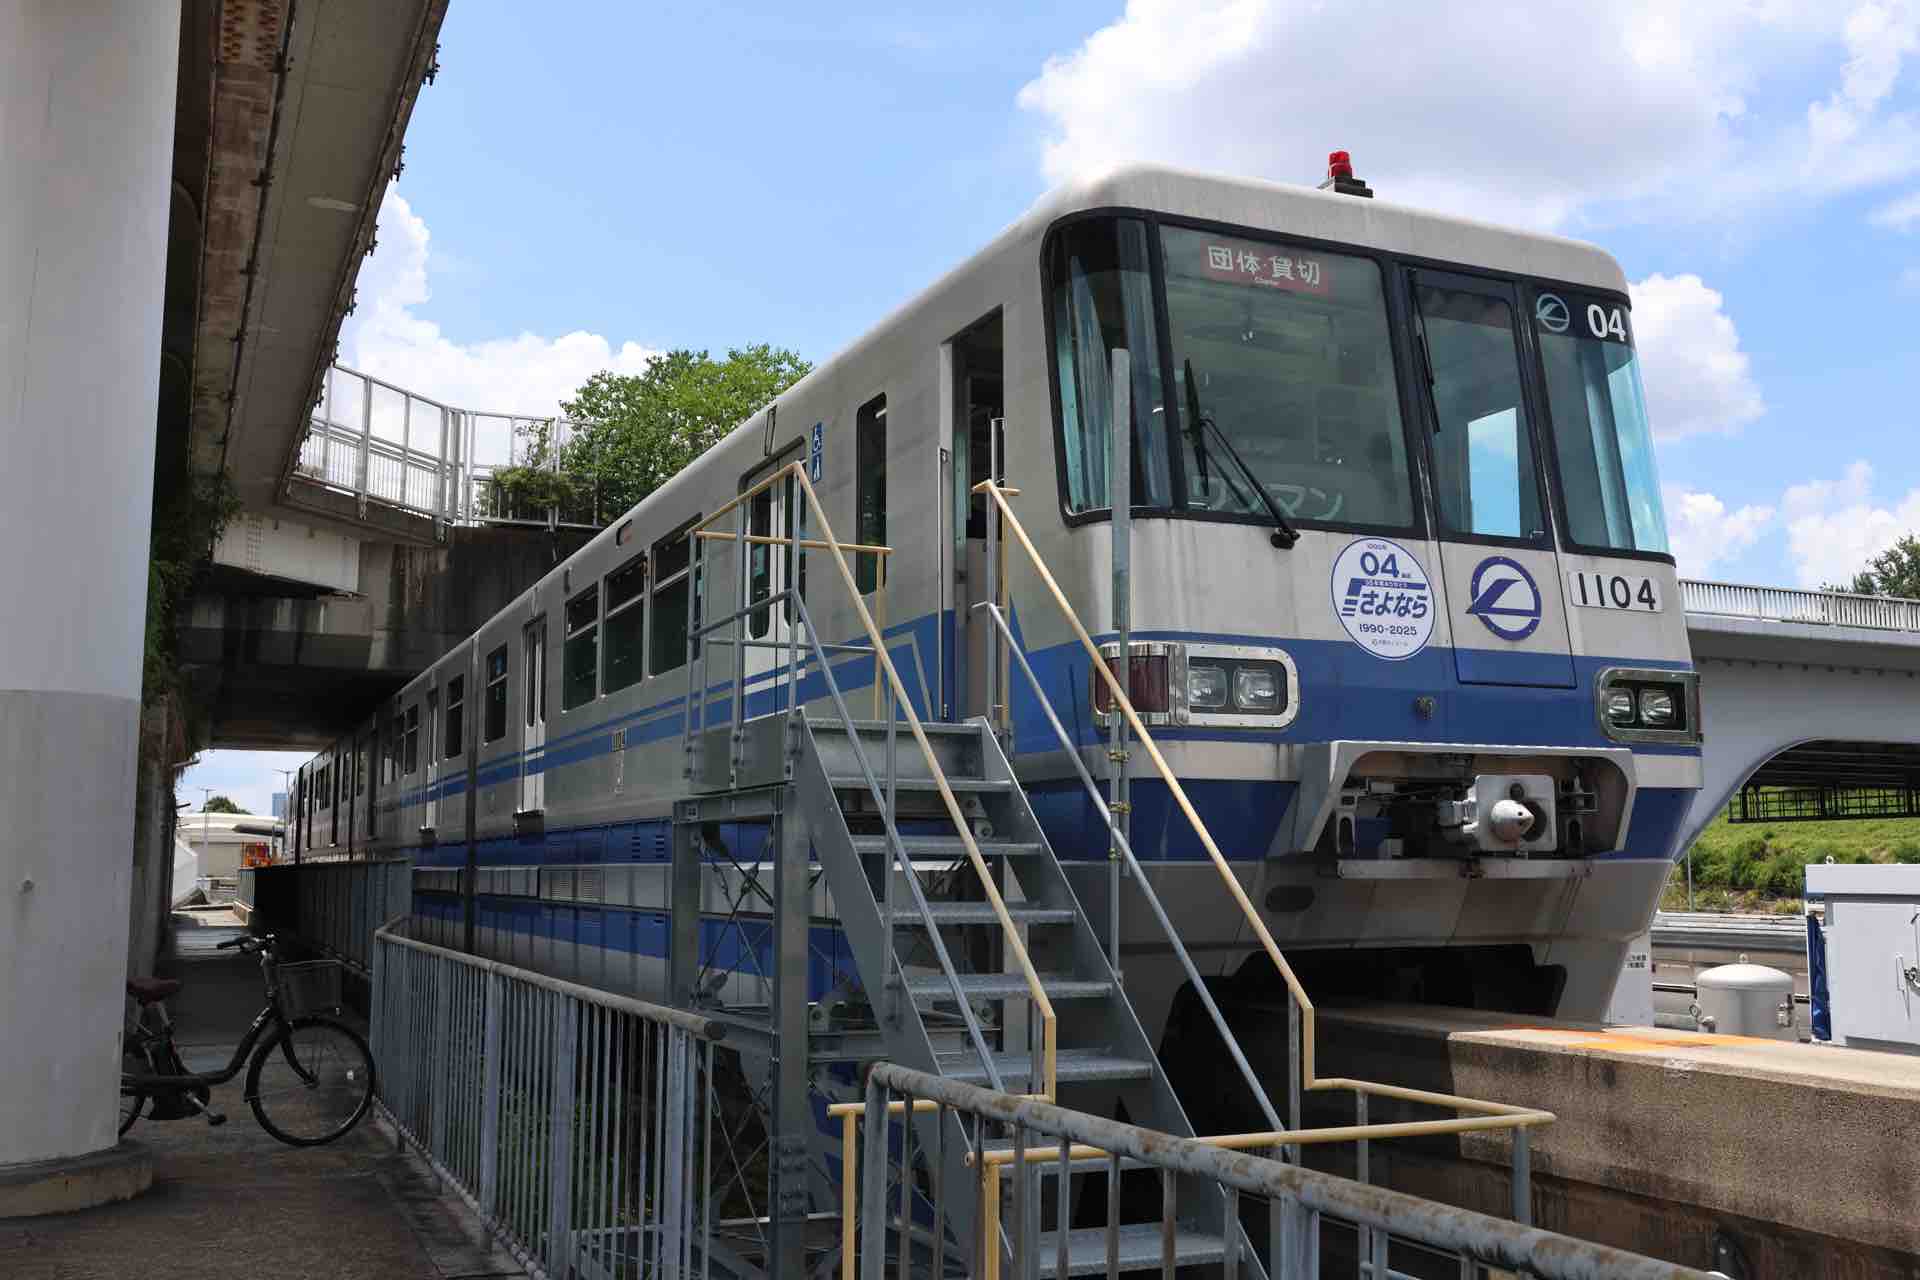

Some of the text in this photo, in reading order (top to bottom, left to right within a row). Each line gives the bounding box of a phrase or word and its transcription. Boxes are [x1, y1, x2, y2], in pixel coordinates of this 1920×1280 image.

[1587, 304, 1626, 341] 04
[1360, 551, 1400, 578] 04
[1360, 590, 1428, 619] さよなら
[1578, 573, 1656, 610] 1104
[1359, 623, 1417, 636] 1990-2025
